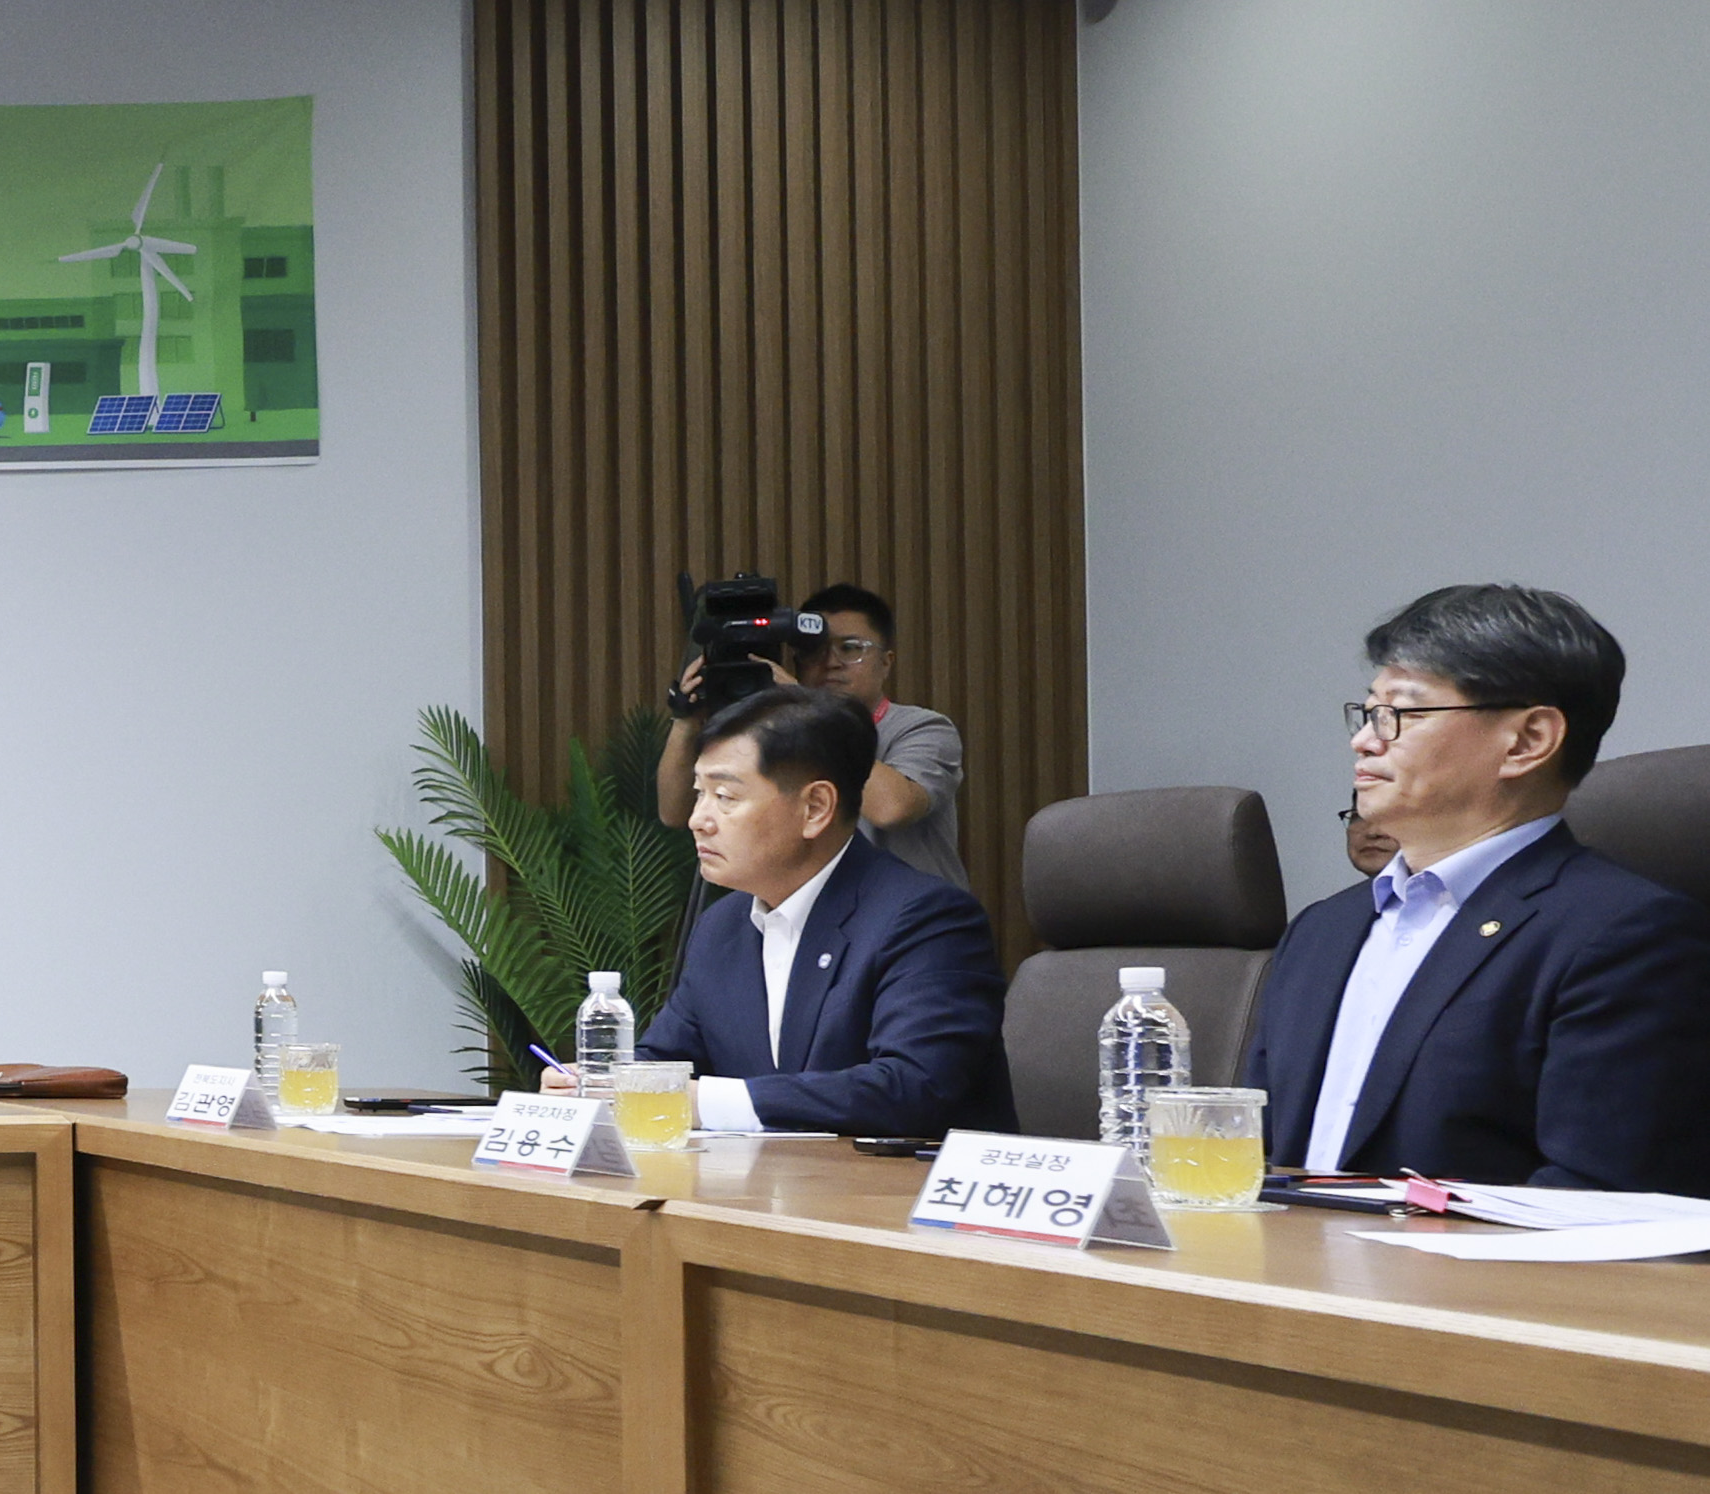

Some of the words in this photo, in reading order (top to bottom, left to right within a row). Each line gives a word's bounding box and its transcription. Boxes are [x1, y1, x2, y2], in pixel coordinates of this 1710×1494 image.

[800, 617, 822, 630] KTV
[174, 1091, 236, 1117] 김관영
[512, 1103, 578, 1121] 국무2차장
[484, 1127, 576, 1159] 김용수
[980, 1149, 1071, 1172] 공보실장
[928, 1176, 1095, 1227] 최혜영
